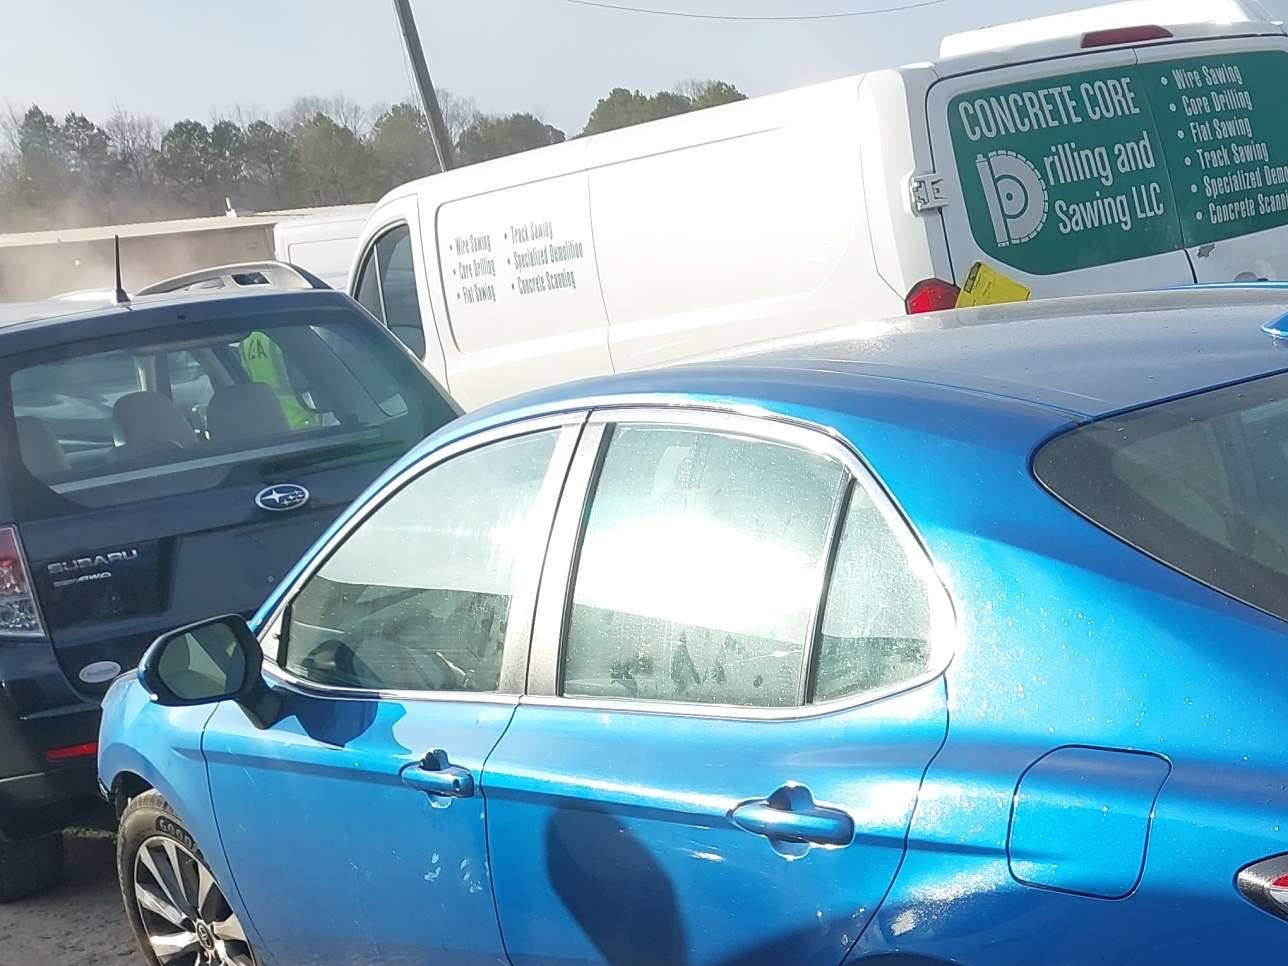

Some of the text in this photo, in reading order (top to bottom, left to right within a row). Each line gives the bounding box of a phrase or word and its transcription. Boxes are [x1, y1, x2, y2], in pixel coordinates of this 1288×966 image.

[1172, 63, 1243, 90] Wire Sawing
[958, 77, 1140, 141] CONCRETE CORE
[1181, 89, 1253, 117] Core Drilling
[1189, 116, 1253, 144] Flat Sawing
[1114, 130, 1156, 174] and
[1196, 140, 1270, 170] Track Sawing
[1203, 167, 1264, 199] Specialized
[1054, 182, 1164, 234] Sawing LLC
[1208, 195, 1256, 224] Concrete
[510, 221, 553, 245] Track Sawing
[472, 257, 496, 278] Drilling
[513, 240, 584, 272] Specialized Demolition
[517, 268, 577, 295] Concrete Scanning
[47, 549, 138, 574] SUBARU
